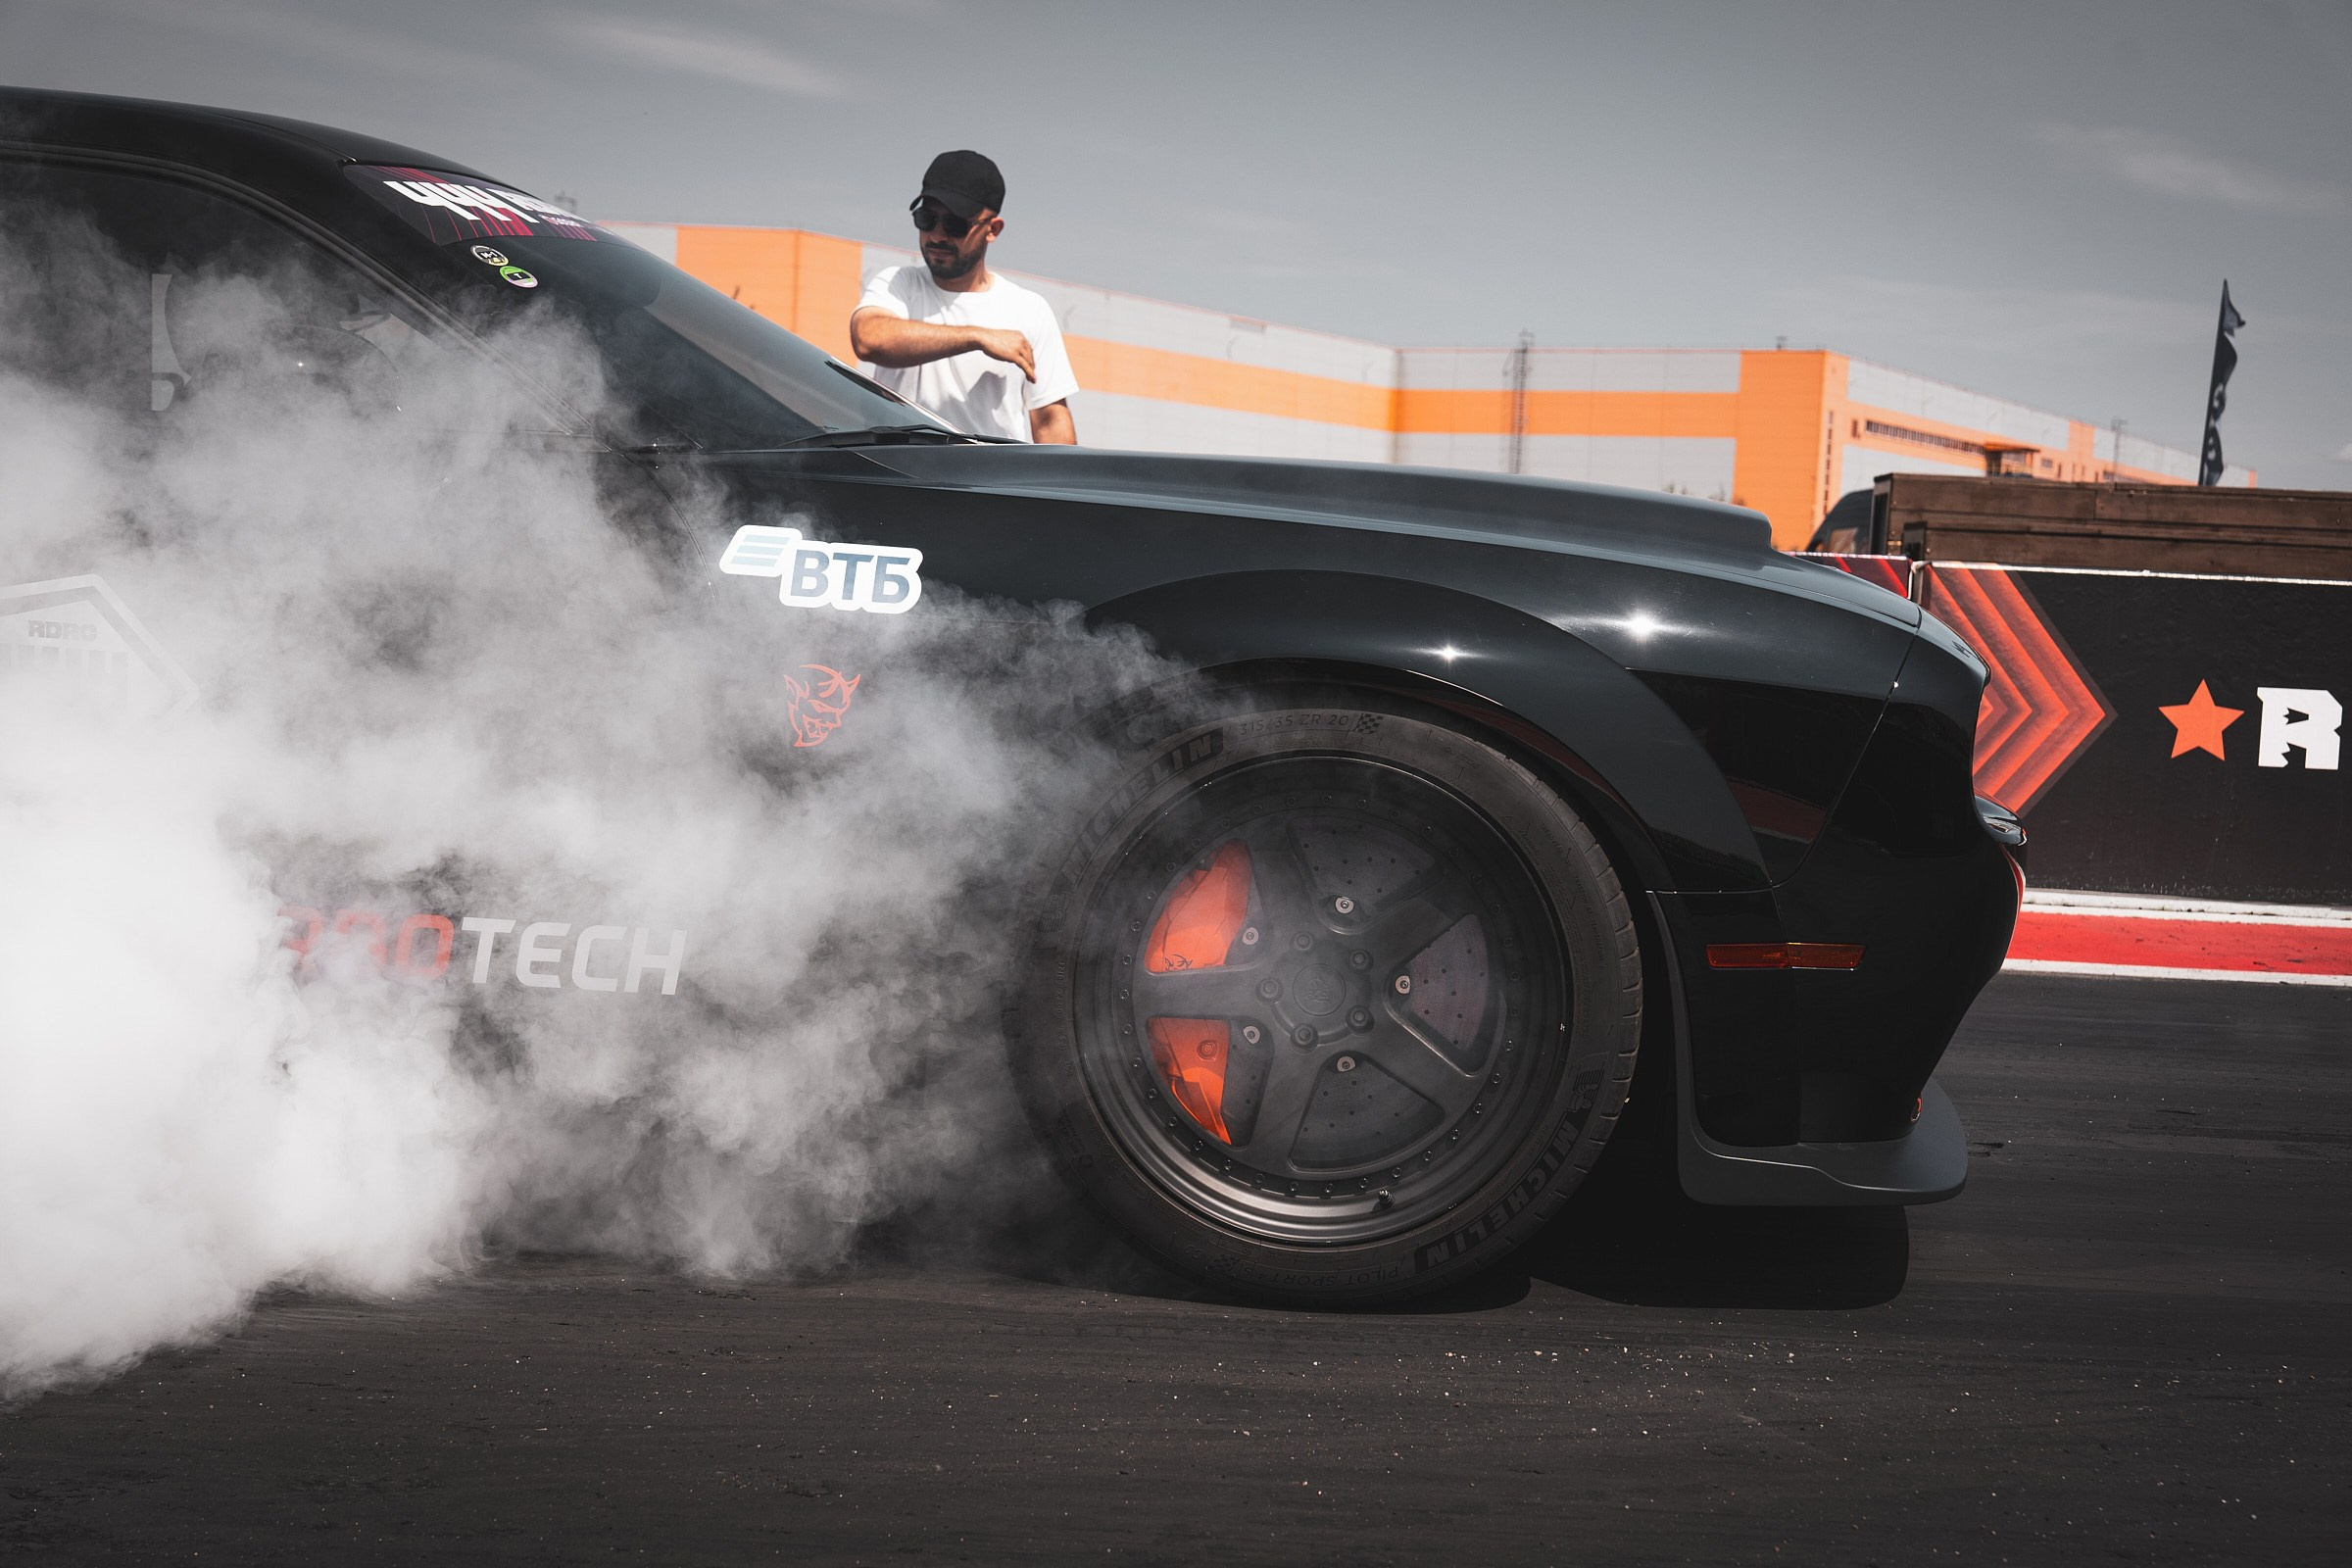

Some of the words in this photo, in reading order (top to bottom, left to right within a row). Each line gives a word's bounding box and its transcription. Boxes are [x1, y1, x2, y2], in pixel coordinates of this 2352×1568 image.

[790, 549, 910, 605] ВТБ
[1240, 714, 1294, 735] 315/35
[1299, 712, 1320, 726] ZR
[1328, 712, 1348, 726] 20
[2257, 687, 2343, 770] R
[1061, 735, 1211, 885] MICHELIN
[1426, 1117, 1581, 1267] MICHELIN
[1269, 1272, 1336, 1287] SPORT
[1344, 1265, 1399, 1286] PILOT
